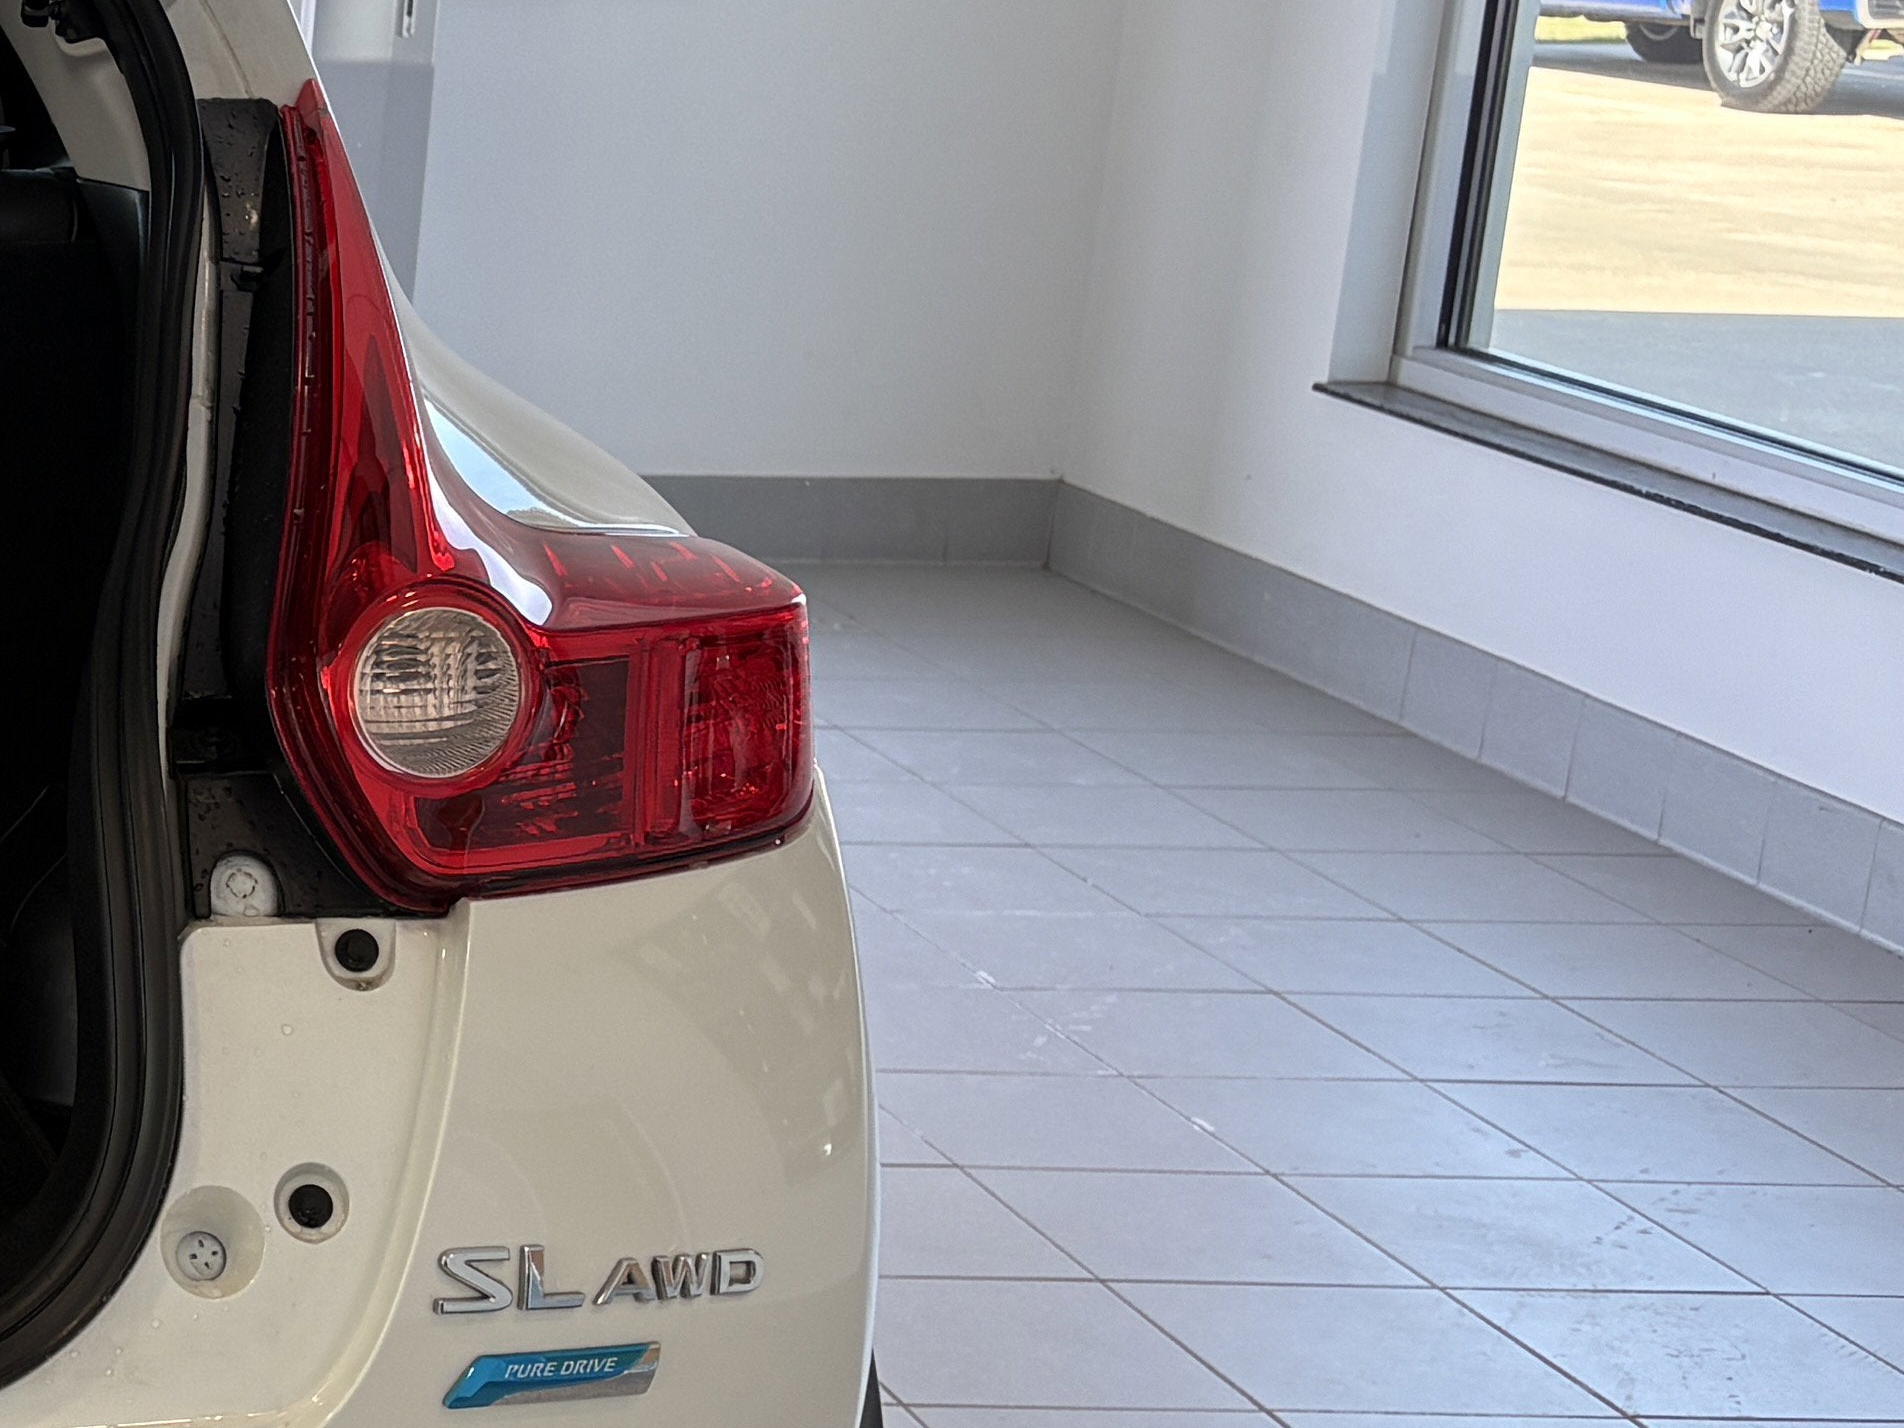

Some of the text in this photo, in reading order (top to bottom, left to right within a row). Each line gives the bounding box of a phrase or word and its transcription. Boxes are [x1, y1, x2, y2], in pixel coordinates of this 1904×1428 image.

[432, 1243, 766, 1315] SL AWD
[504, 1356, 619, 1380] PURE DRIVE
